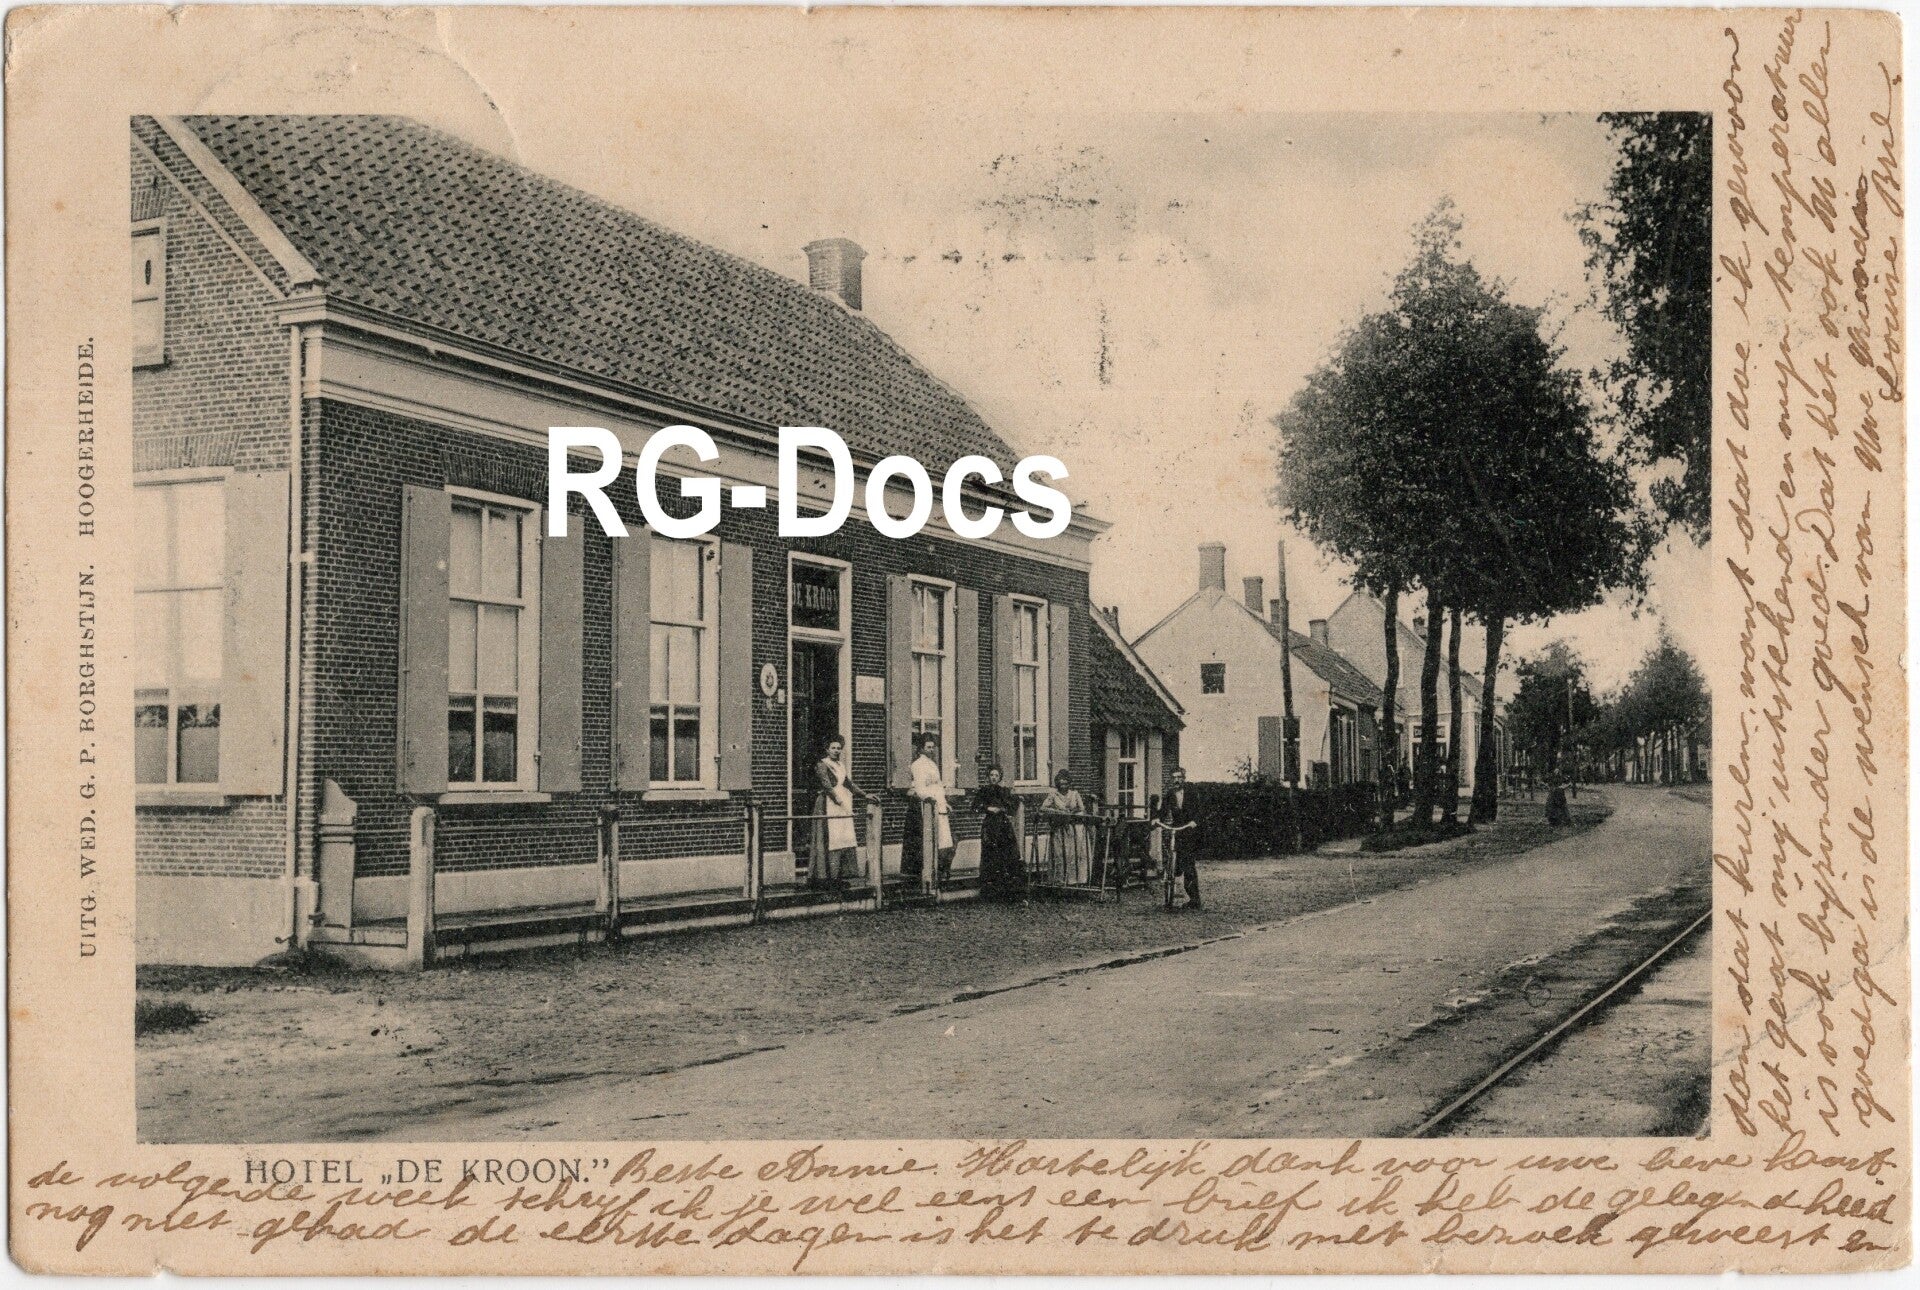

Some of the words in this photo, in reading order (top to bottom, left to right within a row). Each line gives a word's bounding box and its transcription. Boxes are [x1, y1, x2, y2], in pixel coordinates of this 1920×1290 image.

[1798, 20, 1837, 165] allen
[1716, 240, 1753, 321] ik
[1801, 246, 1843, 337] ook
[1726, 341, 1750, 429] doe
[1805, 352, 1839, 439] het
[77, 335, 95, 536] HOOGERHEIDE.
[1726, 437, 1754, 553] dat
[1795, 446, 1839, 560] Dat
[1854, 489, 1873, 586] van
[79, 741, 96, 764] P.
[79, 773, 96, 799] G.
[1758, 1061, 1793, 1132] het
[1779, 451, 1796, 497] en
[79, 808, 96, 878] WED.
[1848, 794, 1877, 863] de
[1842, 871, 1877, 919] is
[1725, 908, 1753, 1014] dat
[1788, 968, 1834, 1065] ook
[1804, 1075, 1840, 1136] is
[27, 1160, 84, 1188] de
[650, 1184, 715, 1220] ik
[789, 1186, 904, 1215] wel
[1046, 1188, 1151, 1208] een
[1337, 1175, 1403, 1217] ik
[1415, 1172, 1520, 1216] heb
[1527, 1186, 1596, 1214] de
[244, 1158, 363, 1185] HOTEL
[1218, 1139, 1365, 1178] dank
[1372, 1156, 1498, 1176] voor
[25, 1202, 114, 1252] nog
[447, 1215, 518, 1246] de
[899, 1214, 954, 1245] is
[963, 1205, 1048, 1244] het
[1062, 1215, 1118, 1246] te
[1838, 1229, 1899, 1252] en
